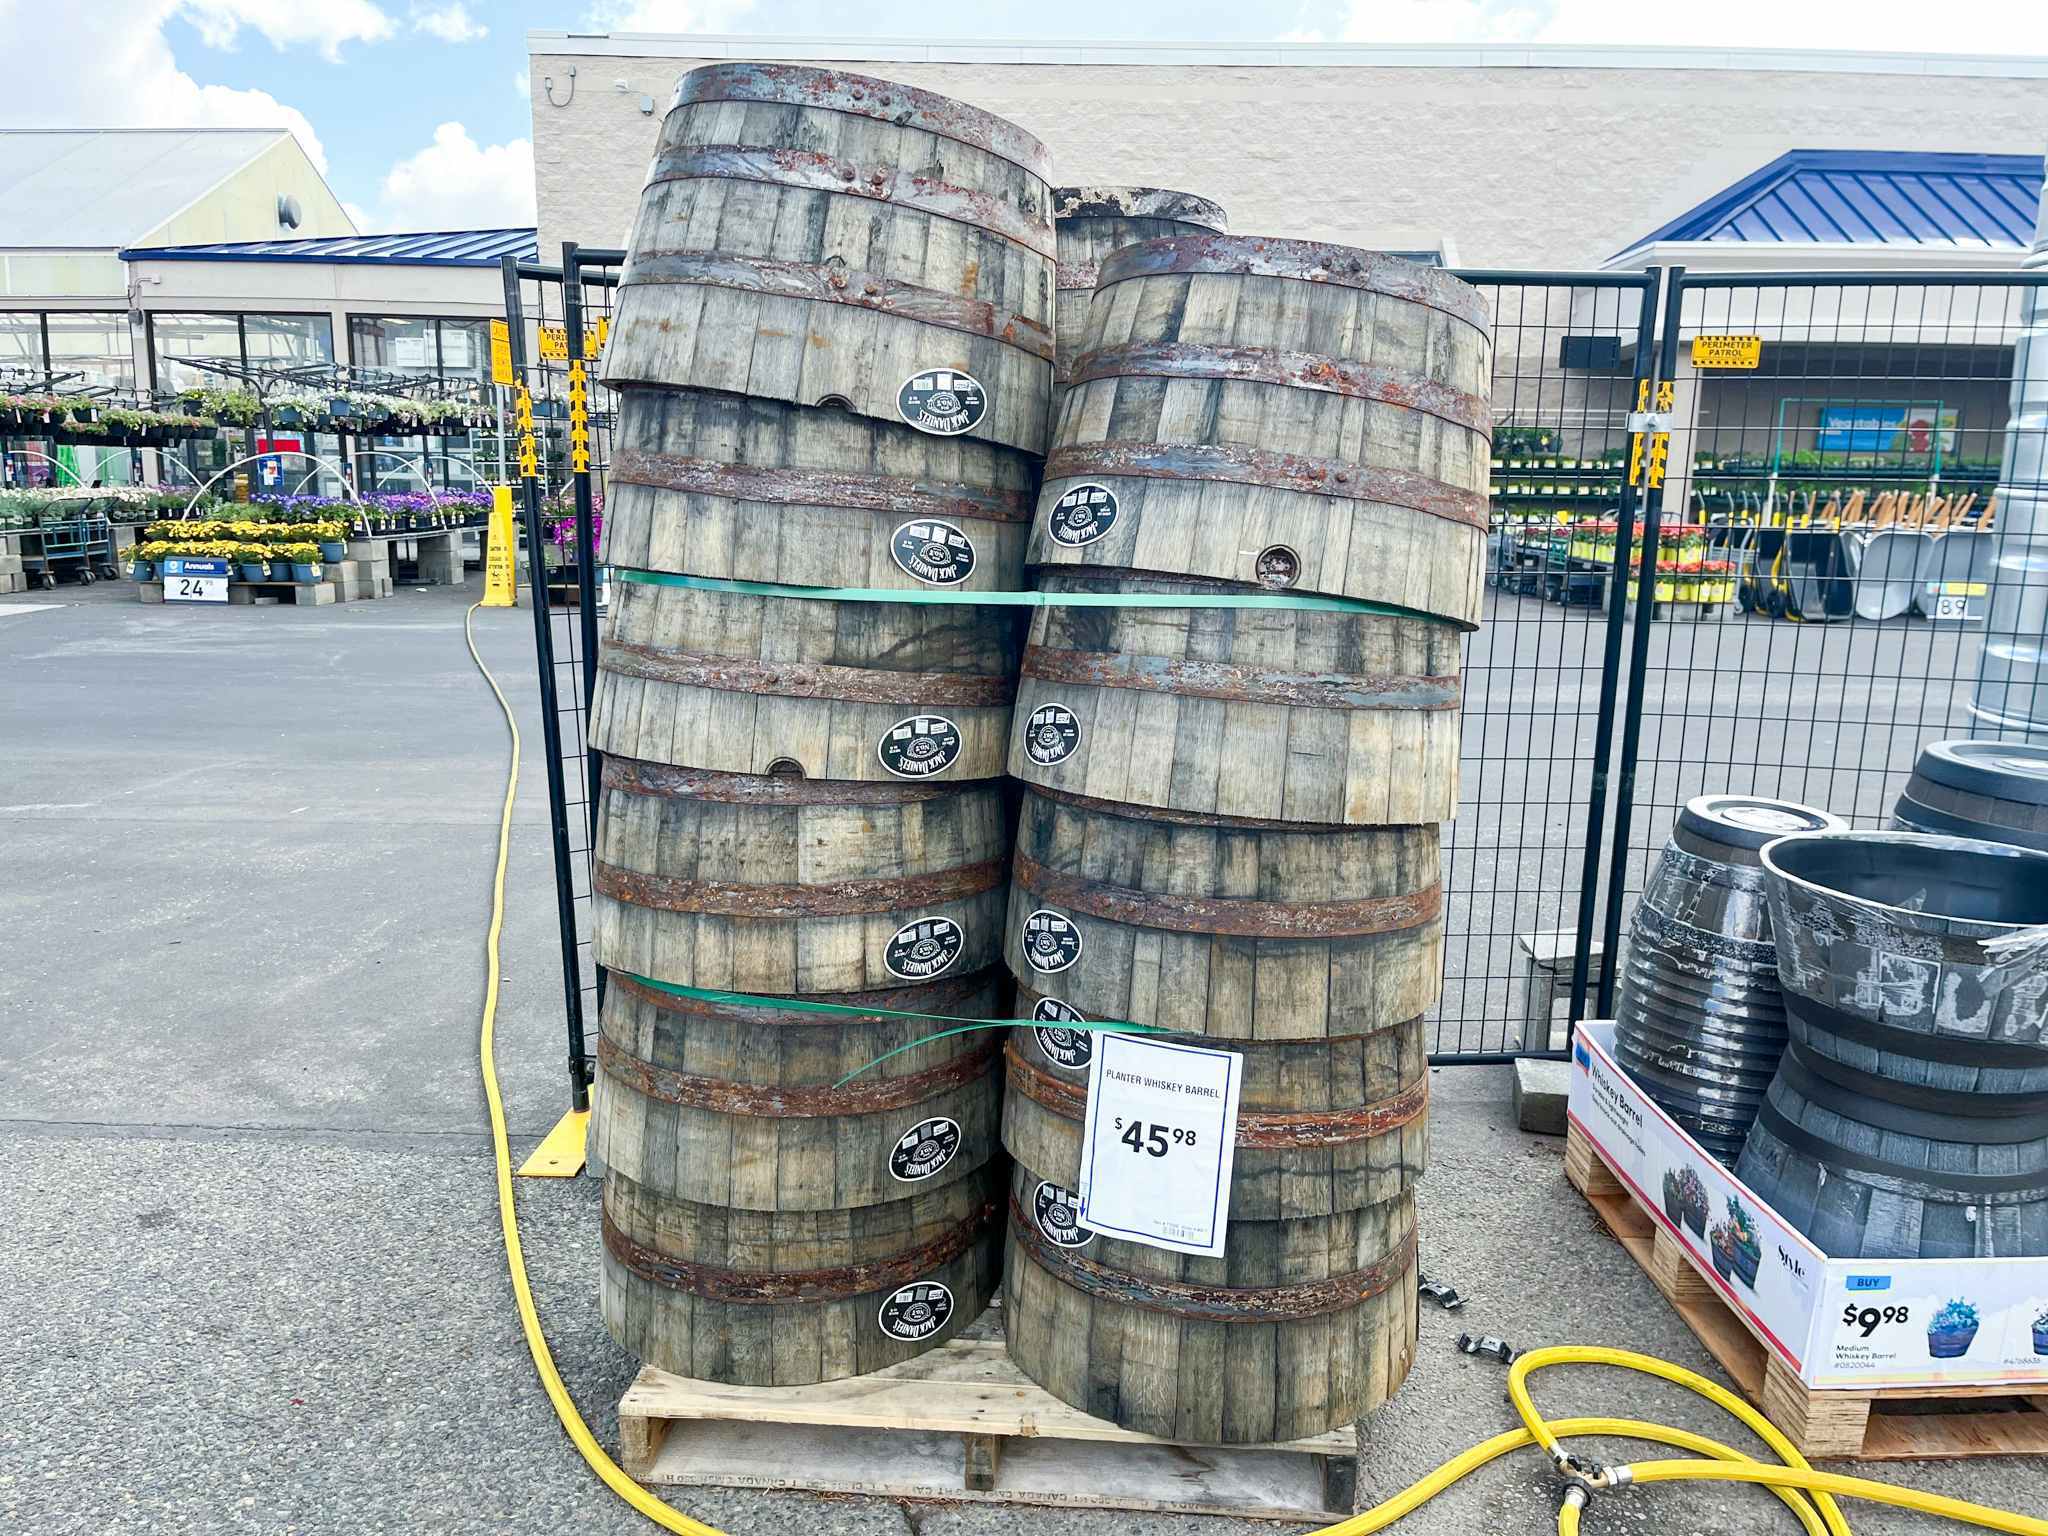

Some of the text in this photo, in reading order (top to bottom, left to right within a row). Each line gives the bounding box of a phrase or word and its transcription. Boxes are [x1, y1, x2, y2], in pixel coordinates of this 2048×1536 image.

[546, 334, 590, 342] PERIR
[1702, 341, 1752, 349] PERIMETER
[917, 407, 970, 432] JACK DANIEL'S
[1081, 521, 1098, 539] JACK
[184, 561, 215, 570] Annuals
[908, 553, 939, 582] DANIEL'S
[938, 563, 958, 580] JACK
[1050, 741, 1065, 759] JACK
[898, 750, 947, 774] JACK DANIEL'S
[901, 949, 949, 974] JACK DANIEL'S
[1049, 949, 1065, 968] JACK
[1058, 1045, 1076, 1064] JACK
[1106, 1069, 1221, 1099] PLANTER WHISKEY BARREL
[1592, 1064, 1643, 1128] Whiskey Barrel
[931, 1148, 946, 1170] JACK
[904, 1161, 931, 1177] DANIEL'S
[1062, 1226, 1079, 1241] JACK
[1778, 1244, 1806, 1278] Style
[1857, 1278, 1880, 1287] BUY
[892, 1315, 936, 1337] JACK DANIEL'S
